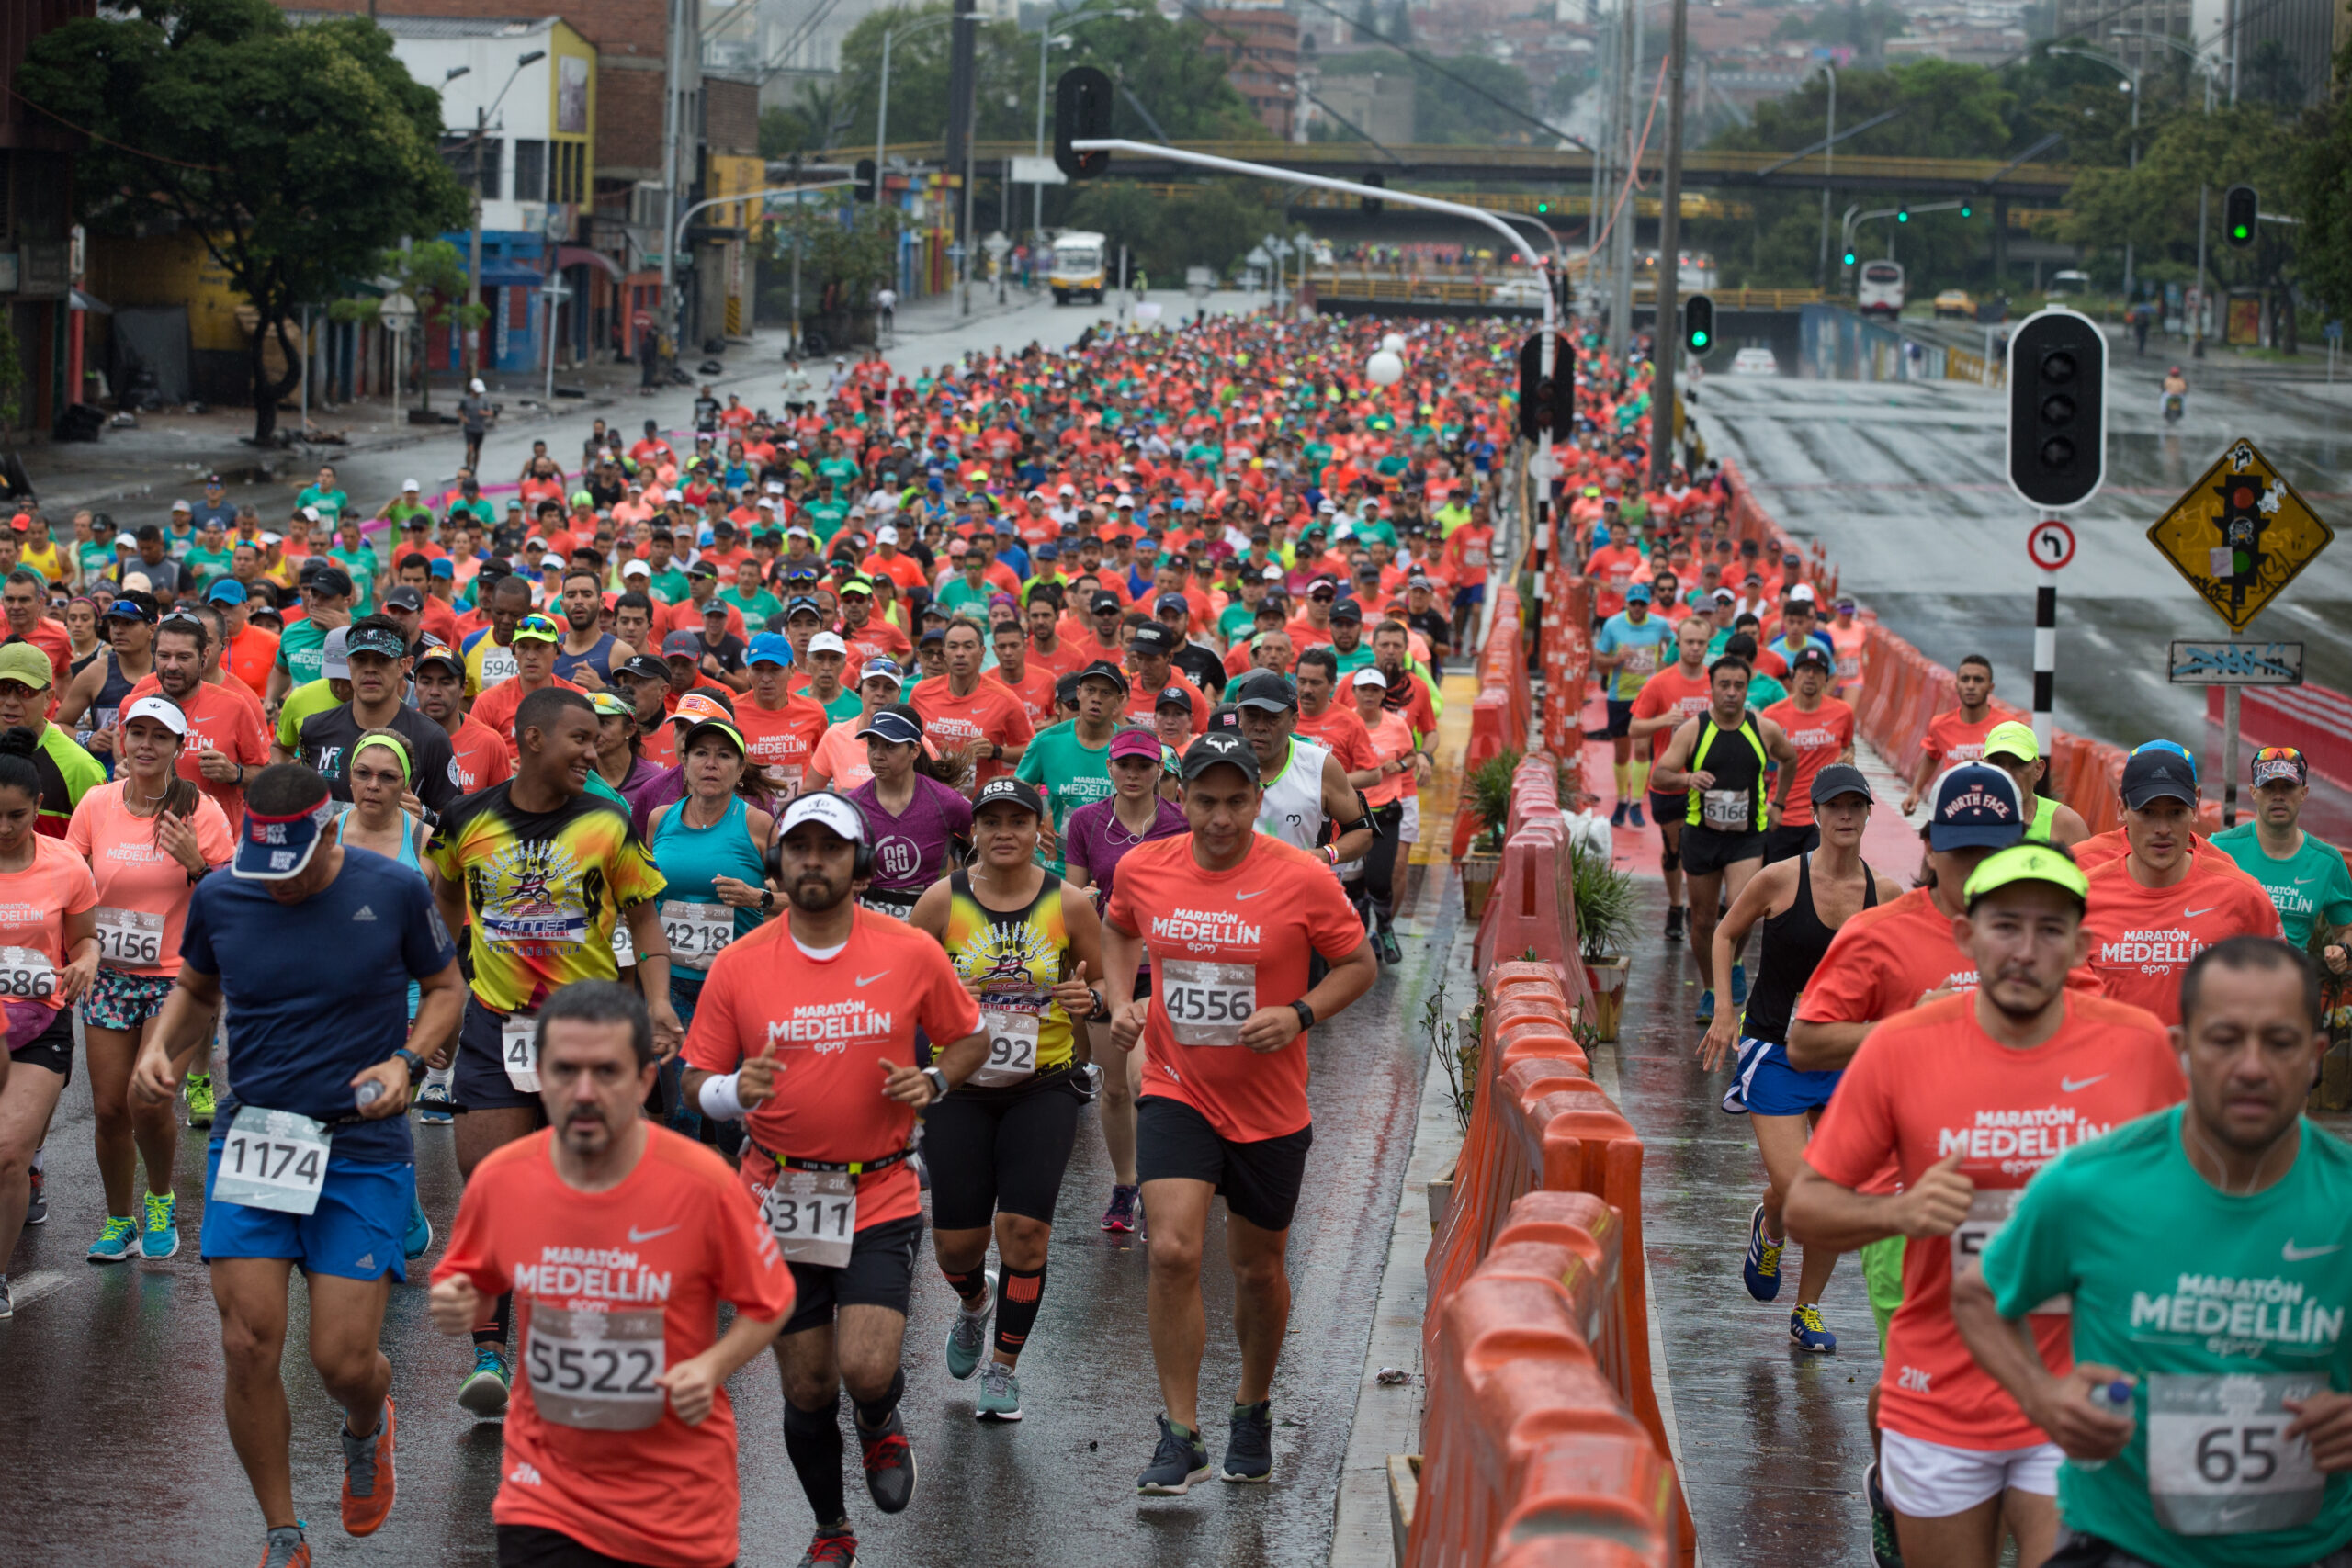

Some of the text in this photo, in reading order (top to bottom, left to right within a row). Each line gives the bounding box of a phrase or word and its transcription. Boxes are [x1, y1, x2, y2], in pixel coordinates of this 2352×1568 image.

[759, 733, 796, 743] MARATÓN
[925, 722, 983, 737] MEDELLÍN
[746, 739, 807, 755] MEDELLÍN
[983, 781, 1015, 796] RSS
[1073, 776, 1112, 786] MARATÓN
[1945, 793, 2010, 818] NORTH FACE
[106, 848, 164, 863] MEDELLÍN
[2261, 885, 2299, 897] ARATÓN
[0, 902, 31, 911] ARATÓN
[2270, 896, 2313, 913] ELLÍN
[0, 908, 44, 922] DELLÍN
[1172, 908, 1239, 925] MARATÓN
[497, 920, 568, 931] RUNNER
[1151, 916, 1261, 945] MEDELLÍN
[665, 922, 729, 951] 4218
[2123, 928, 2190, 942] MARATÓN
[1187, 942, 1217, 955] epm
[2141, 964, 2172, 976] epm
[793, 999, 865, 1020] MARATÓN
[1167, 987, 1253, 1021] 4556
[768, 1009, 892, 1042] MEDELLÍN
[814, 1038, 846, 1055] epm
[991, 1036, 1032, 1069] 92
[1975, 1105, 2075, 1127] MARATÓN
[232, 1137, 320, 1185] 1174
[829, 1179, 847, 1190] 21K
[542, 1246, 639, 1270] MARATÓN
[514, 1261, 673, 1303] MEDELLÍN
[2177, 1272, 2304, 1305] MARATÓN
[2130, 1291, 2345, 1344] MEDELLÍN
[528, 1338, 658, 1394] 5522
[1897, 1365, 1932, 1395] 21K
[2196, 1426, 2278, 1484] 65
